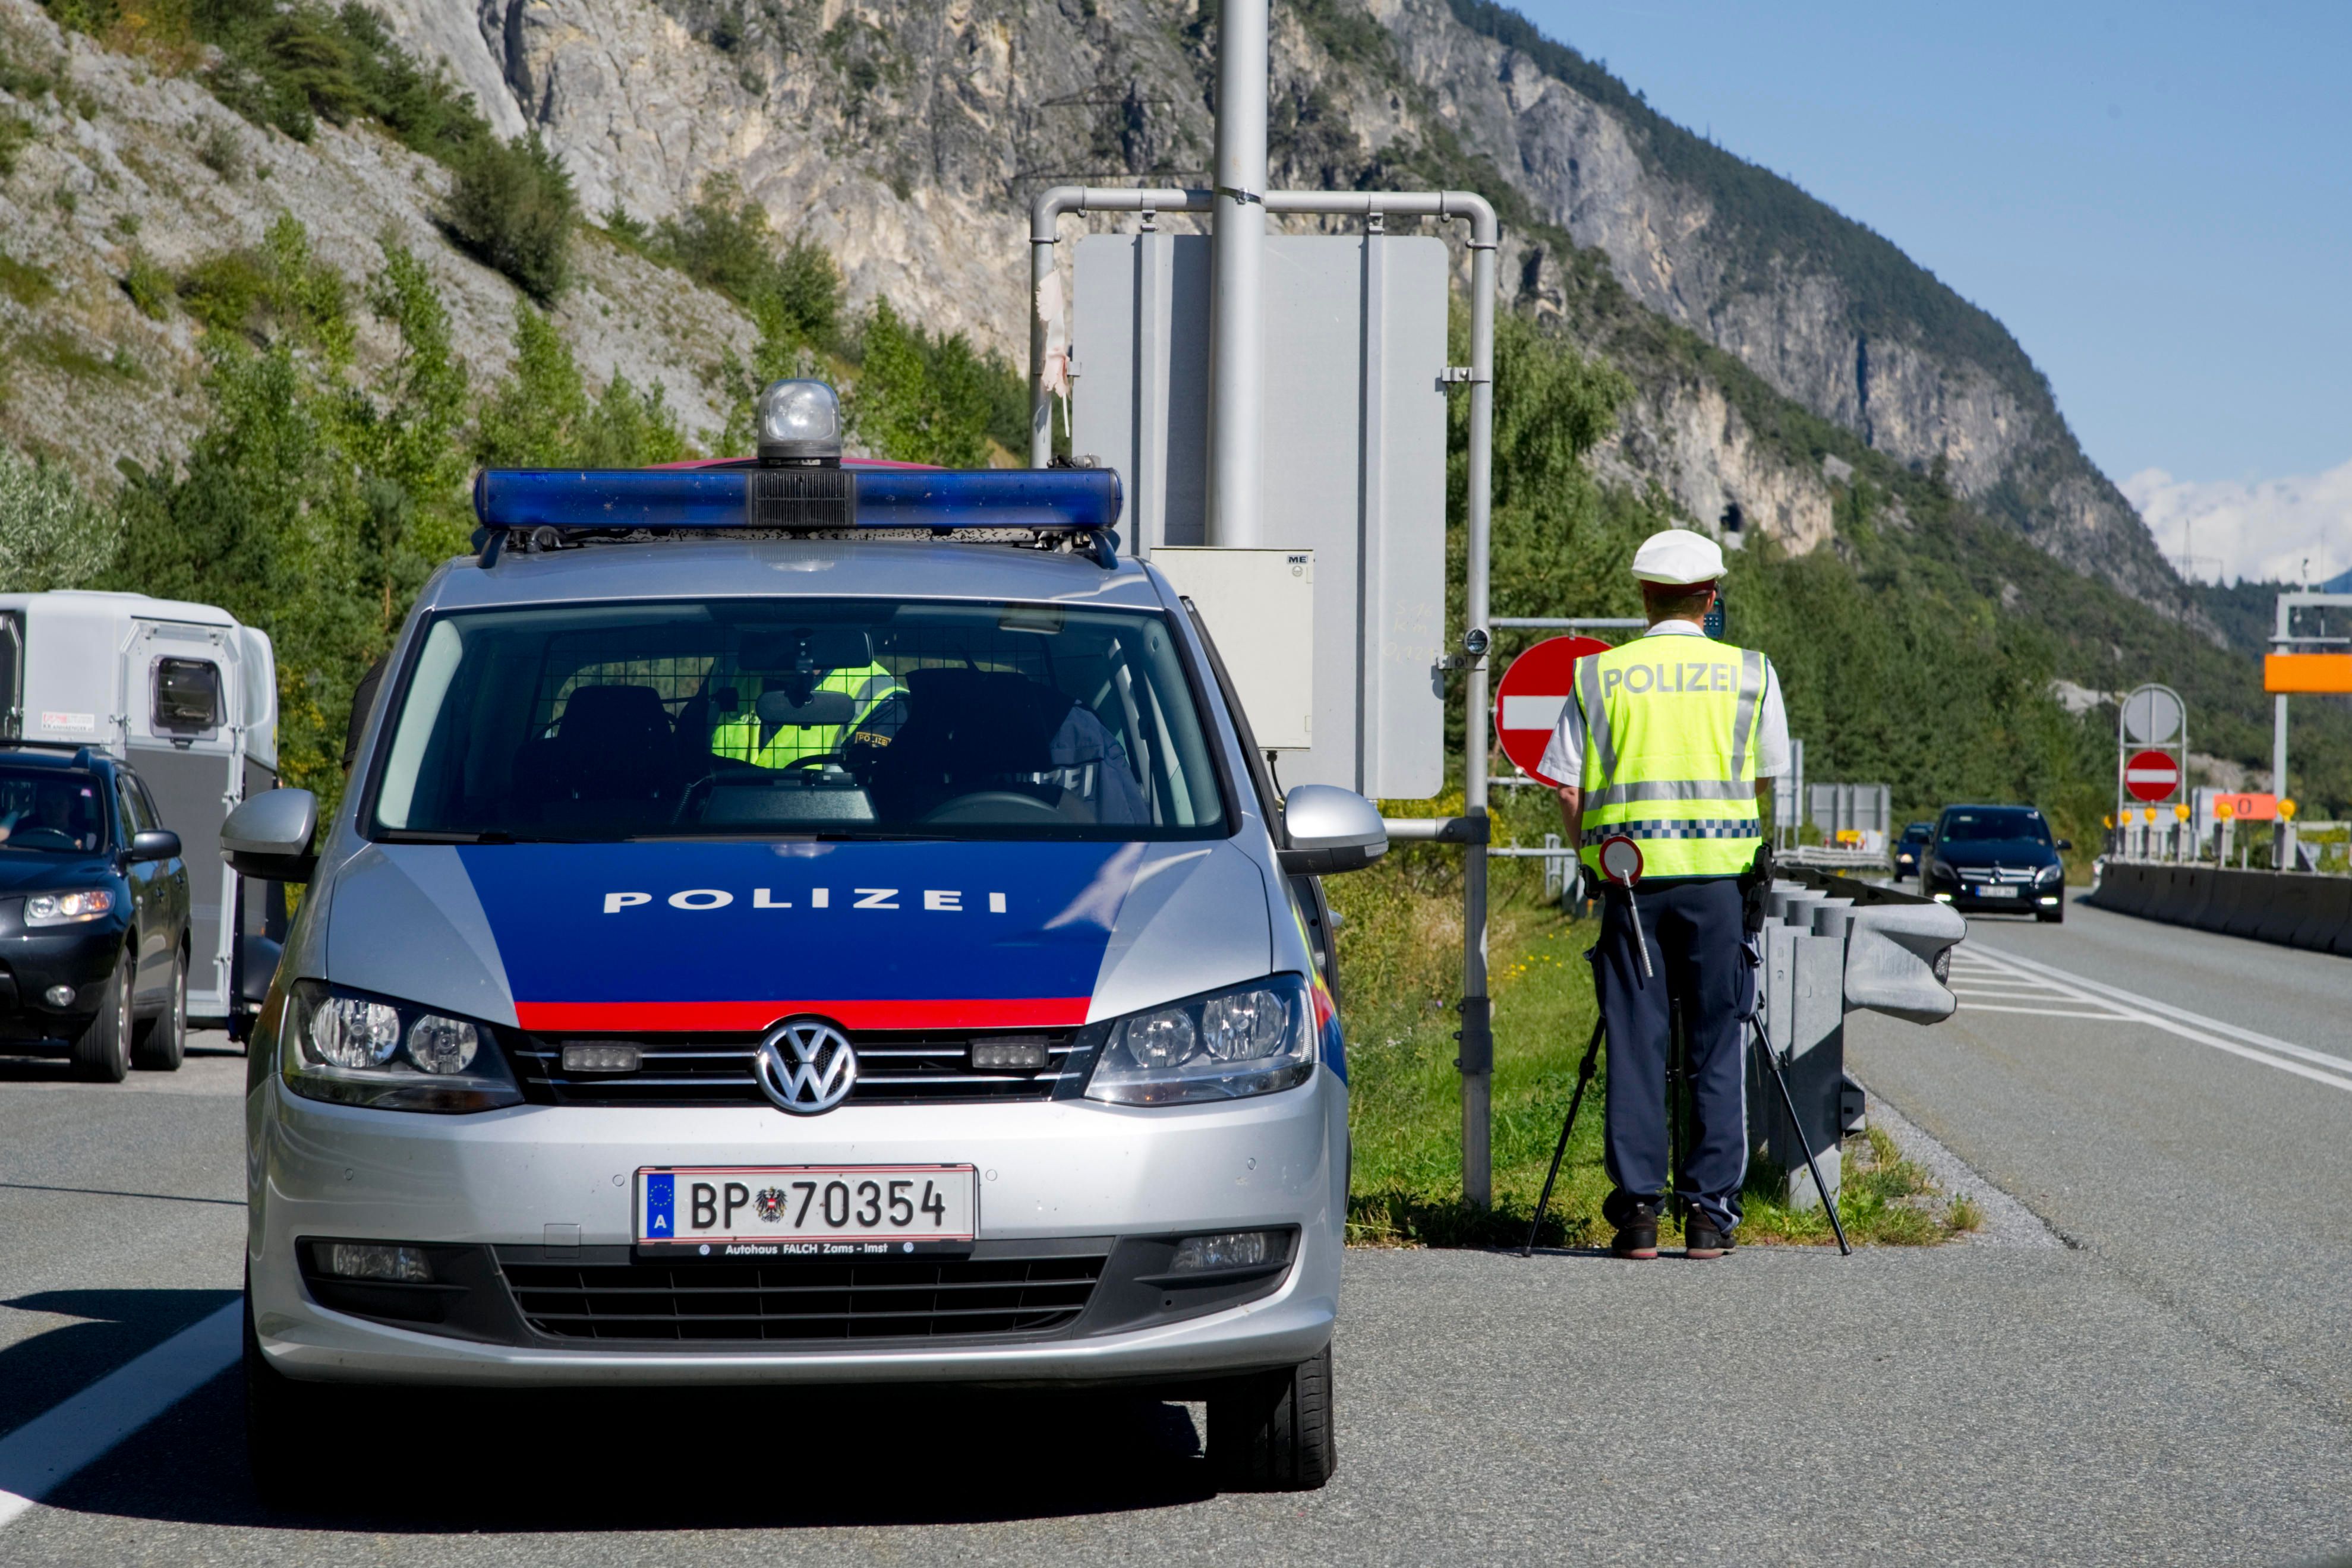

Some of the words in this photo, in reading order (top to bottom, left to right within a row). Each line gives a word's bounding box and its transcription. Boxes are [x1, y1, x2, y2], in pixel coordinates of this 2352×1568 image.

[1603, 662, 1738, 699] POLIZEI
[603, 888, 1007, 914] POLIZEI
[691, 1182, 750, 1229] BP
[792, 1180, 946, 1228] 70354
[654, 1214, 667, 1229] A
[725, 1244, 778, 1255] Autohaus
[783, 1244, 818, 1254] FALCH
[823, 1244, 853, 1254] Zams
[864, 1243, 888, 1253] Imst
